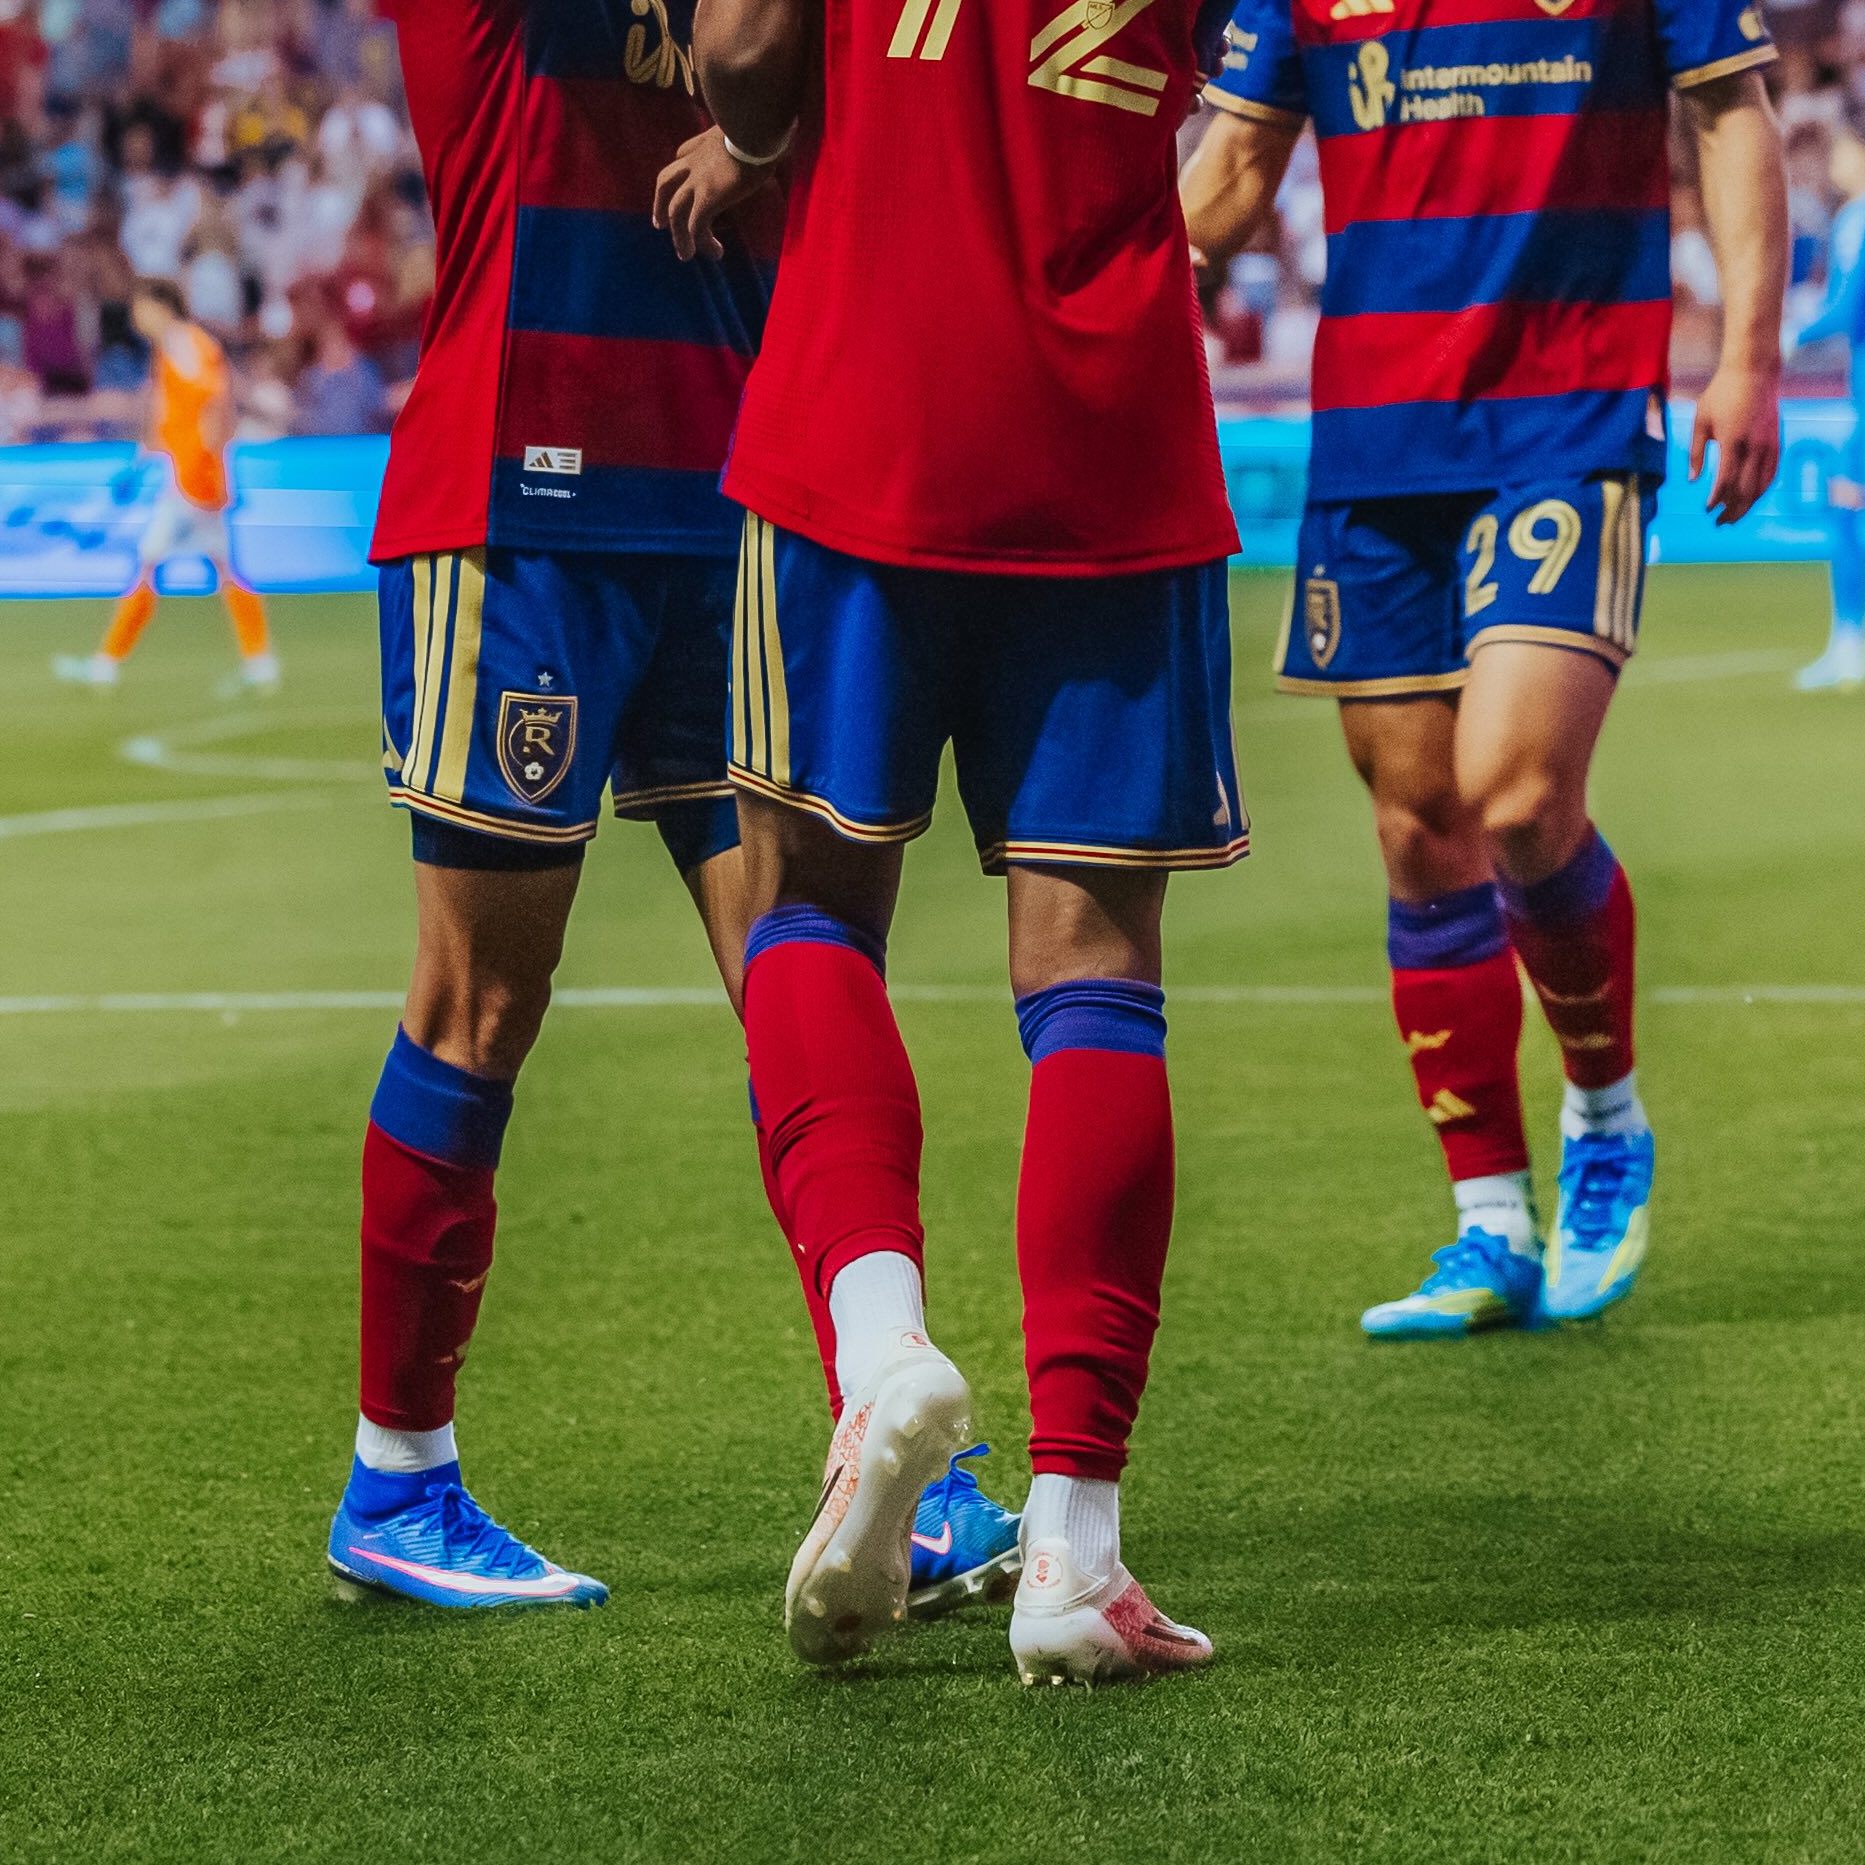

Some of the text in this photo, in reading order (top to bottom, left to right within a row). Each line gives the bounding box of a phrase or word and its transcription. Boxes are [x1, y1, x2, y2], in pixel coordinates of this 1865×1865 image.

[1400, 54, 1593, 91] Intermountain
[1400, 91, 1485, 123] Health
[1465, 498, 1582, 618] 29
